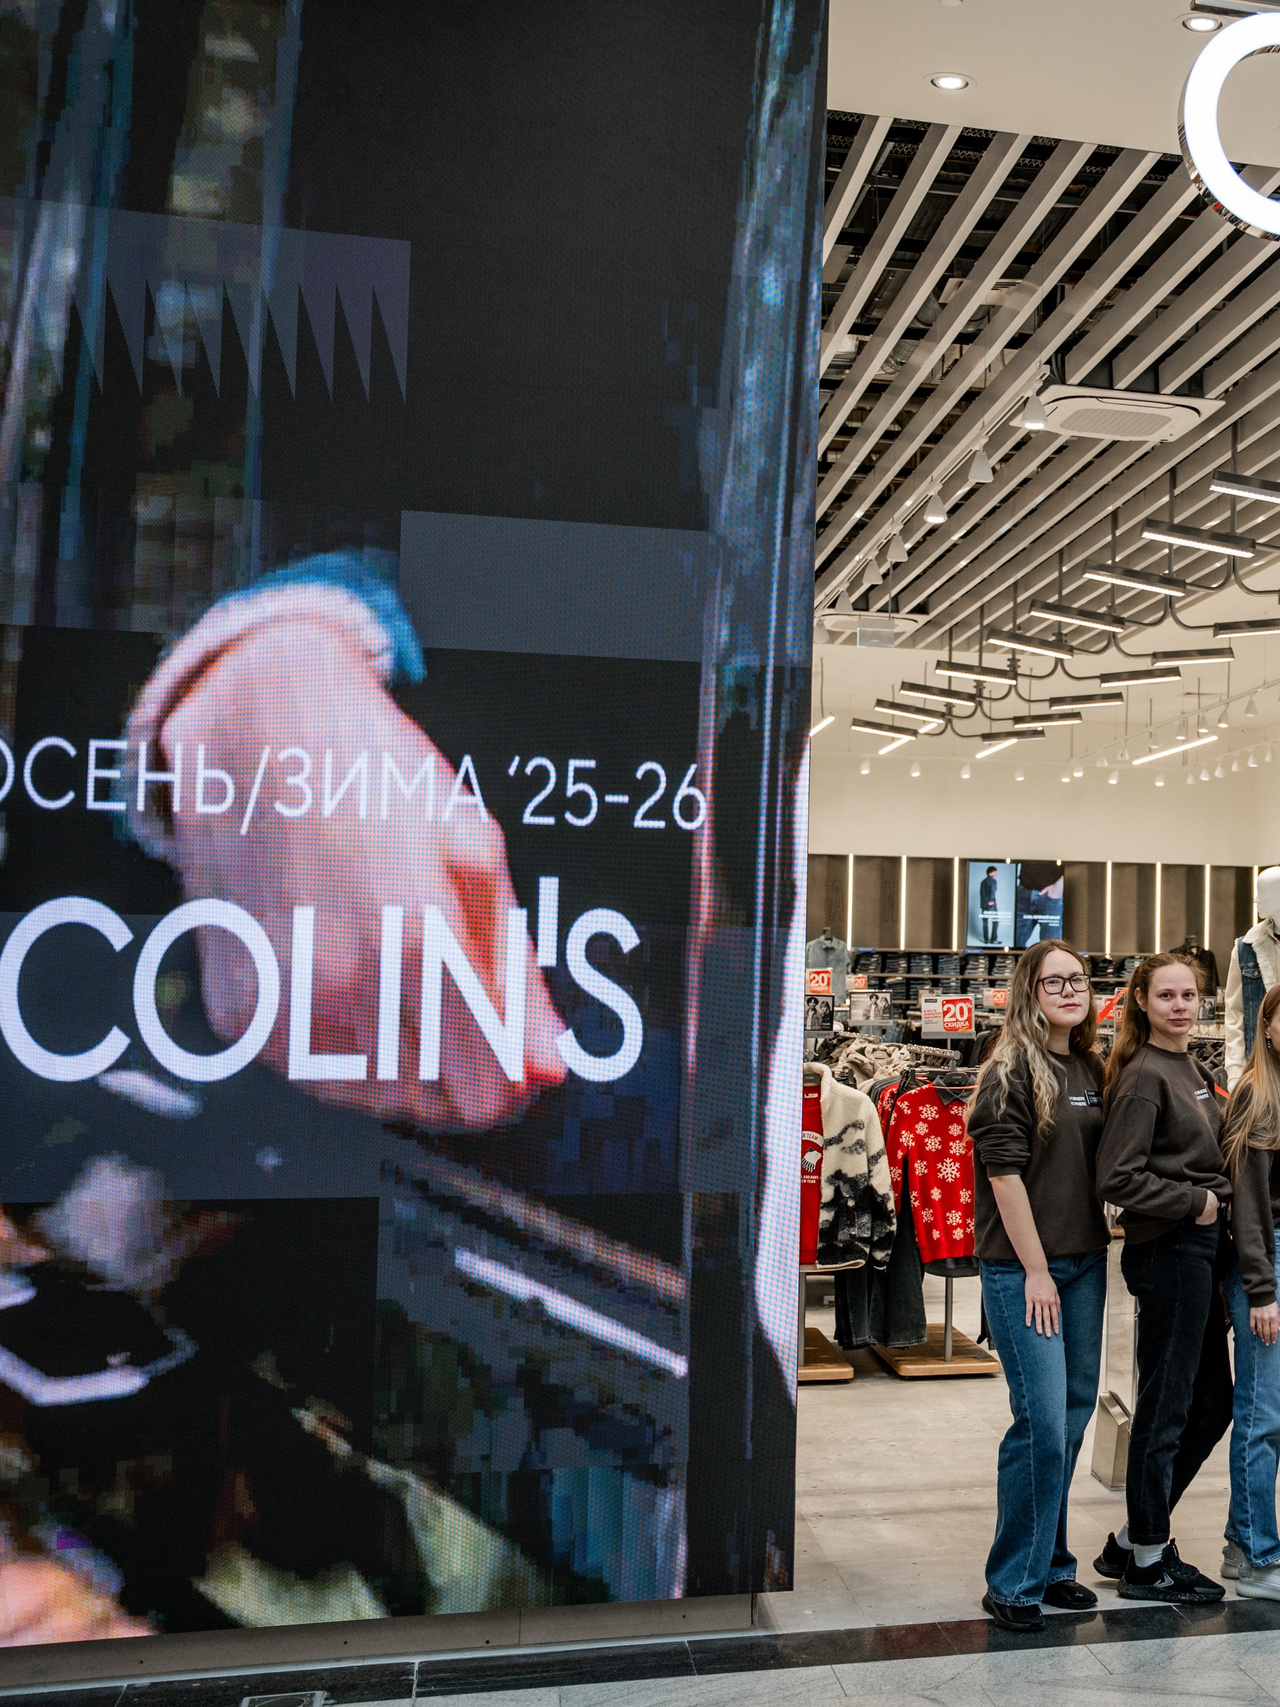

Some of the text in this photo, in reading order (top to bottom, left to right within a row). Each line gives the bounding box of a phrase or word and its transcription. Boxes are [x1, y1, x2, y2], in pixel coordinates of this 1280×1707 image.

[0, 736, 489, 835] СЕНЬ/ЗИМА
[0, 877, 643, 1082] COLIN'S
[944, 1021, 970, 1029] СКИДКА
